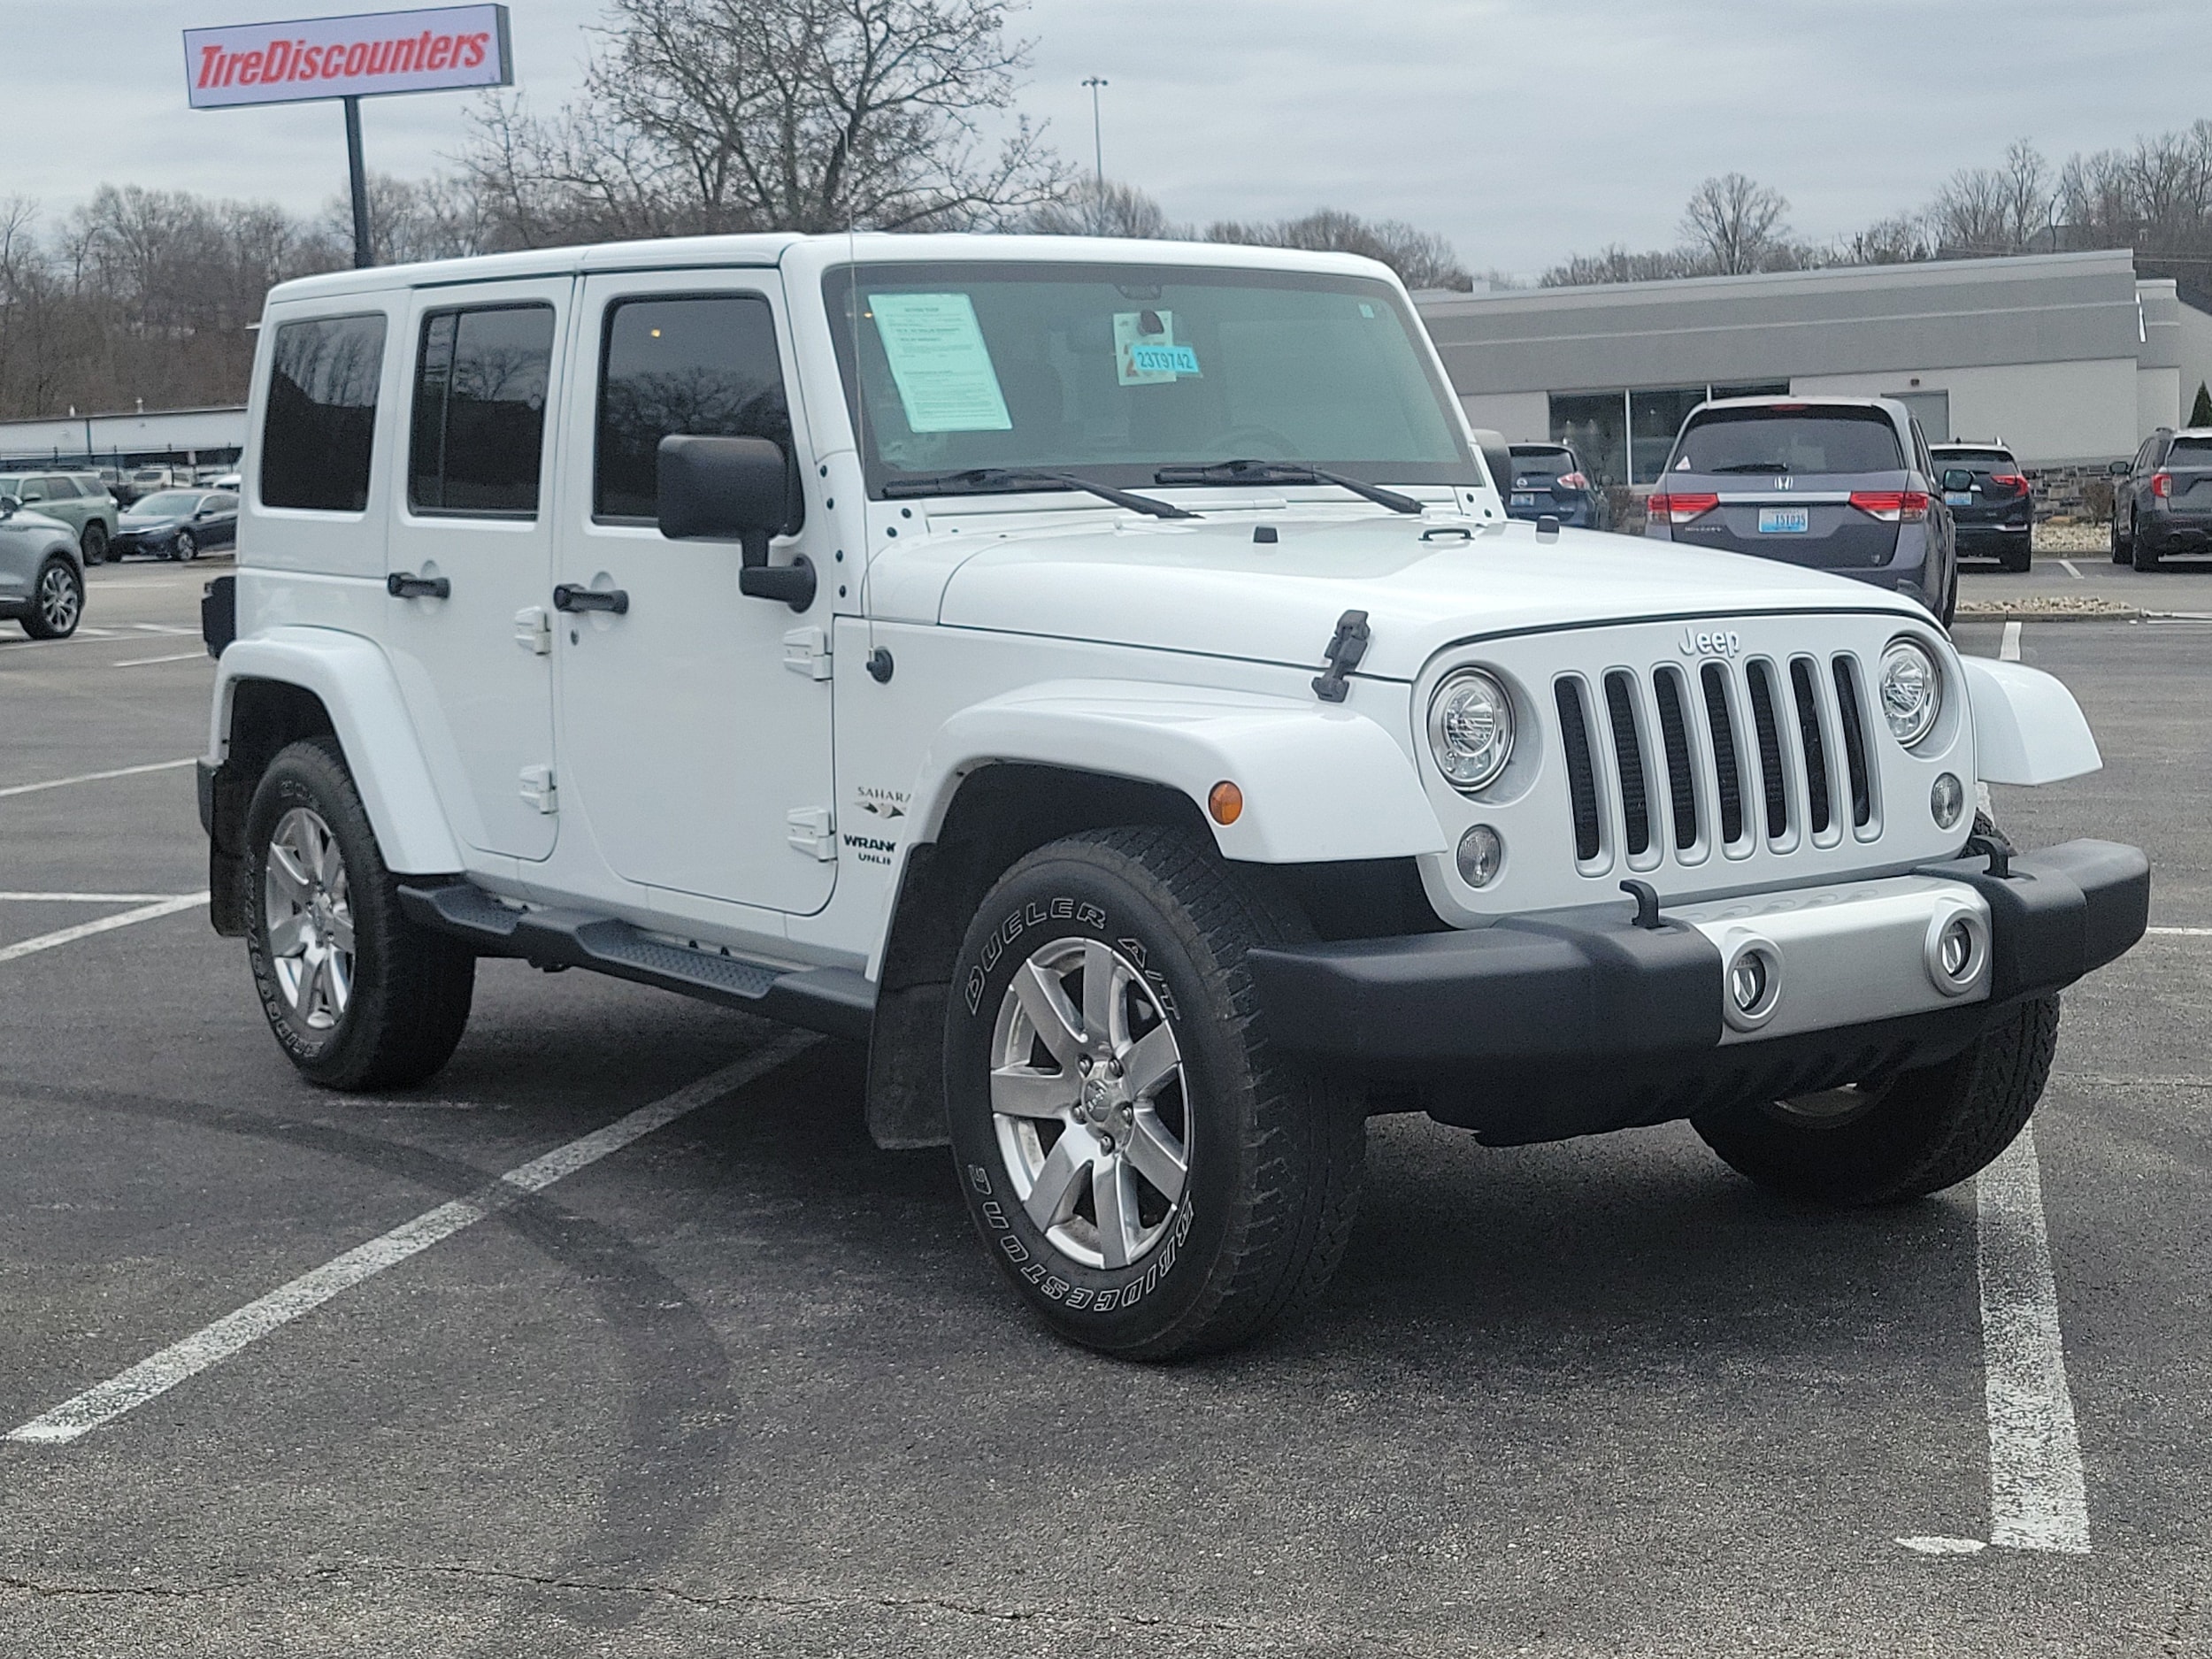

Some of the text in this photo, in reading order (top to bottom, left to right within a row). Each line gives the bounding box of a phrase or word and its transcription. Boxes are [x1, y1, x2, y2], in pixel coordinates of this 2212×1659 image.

[197, 29, 490, 88] TireDiscounters
[1137, 352, 1194, 369] 23T9742
[1678, 626, 1740, 658] Jeep
[964, 897, 1181, 1021] DUELER A/T
[967, 1164, 1194, 1312] BRIDGESTONE
